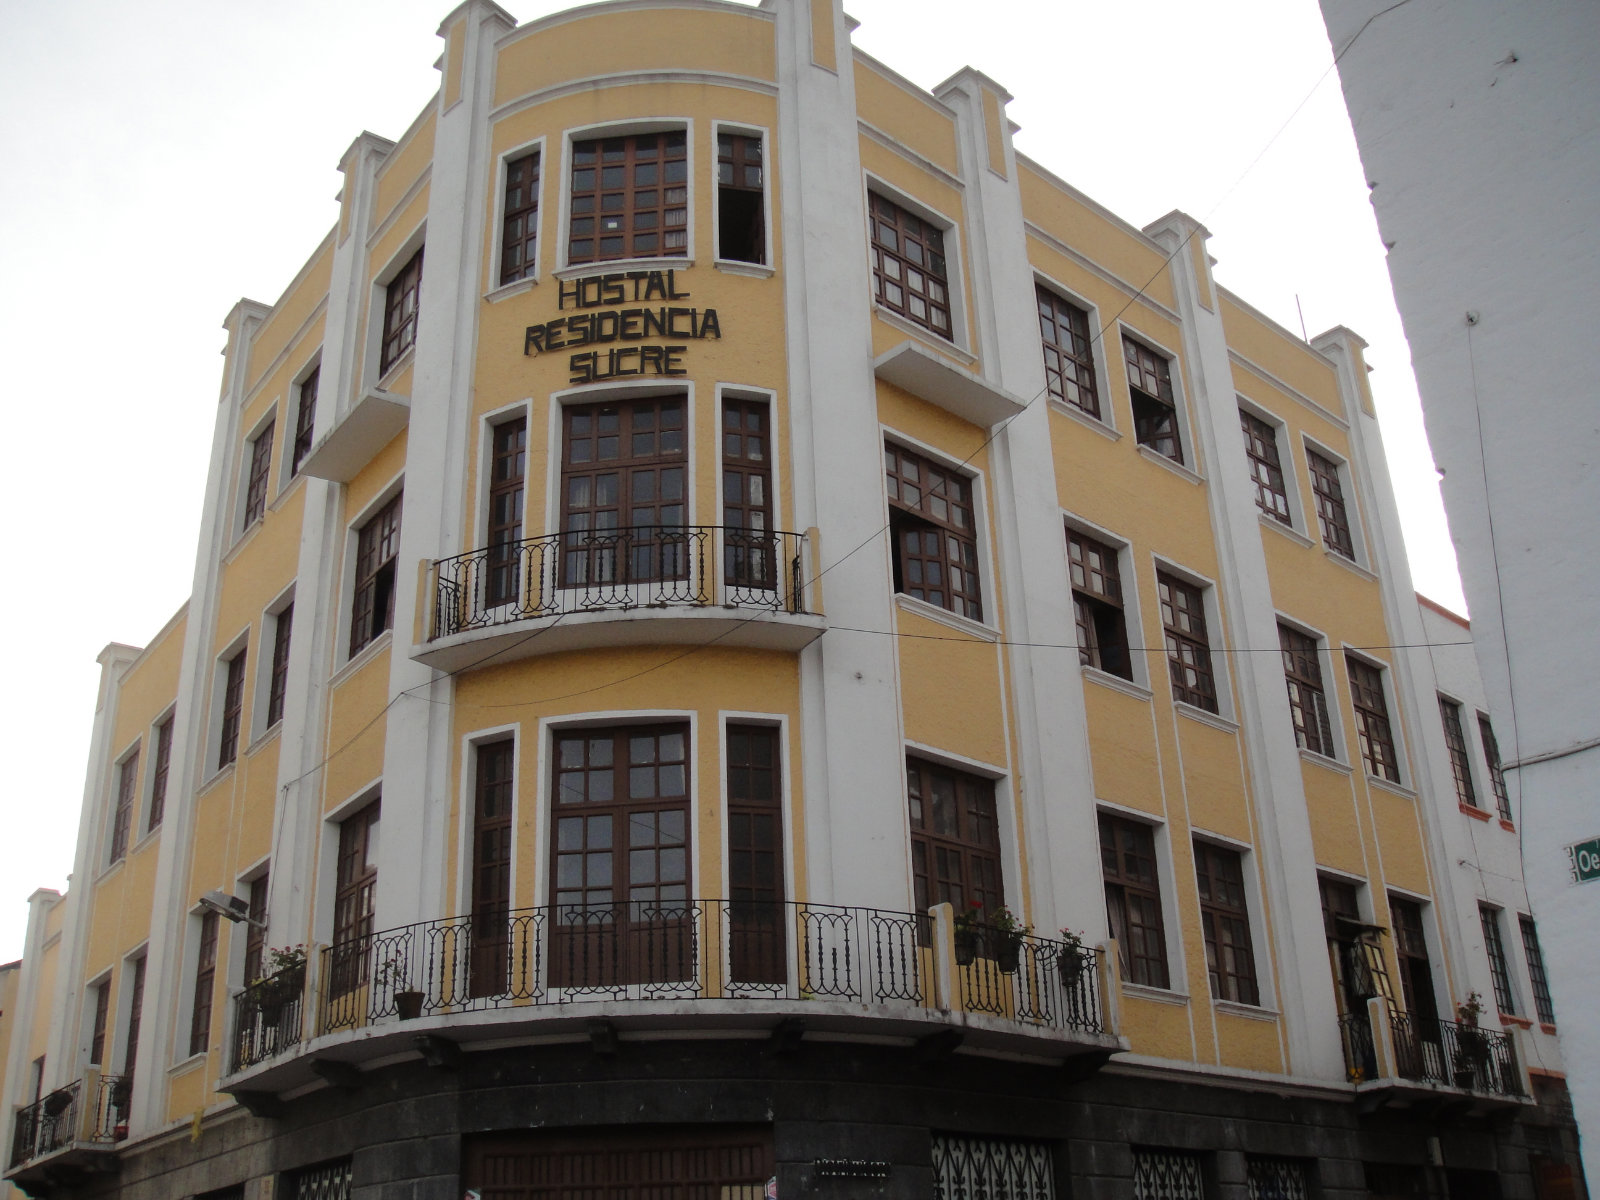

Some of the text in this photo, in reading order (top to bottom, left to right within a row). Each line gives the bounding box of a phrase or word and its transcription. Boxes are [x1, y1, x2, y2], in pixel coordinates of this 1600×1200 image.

[558, 269, 690, 310] HOSTAL
[524, 307, 721, 356] RESIDENCIA
[569, 346, 687, 383] SUCRE
